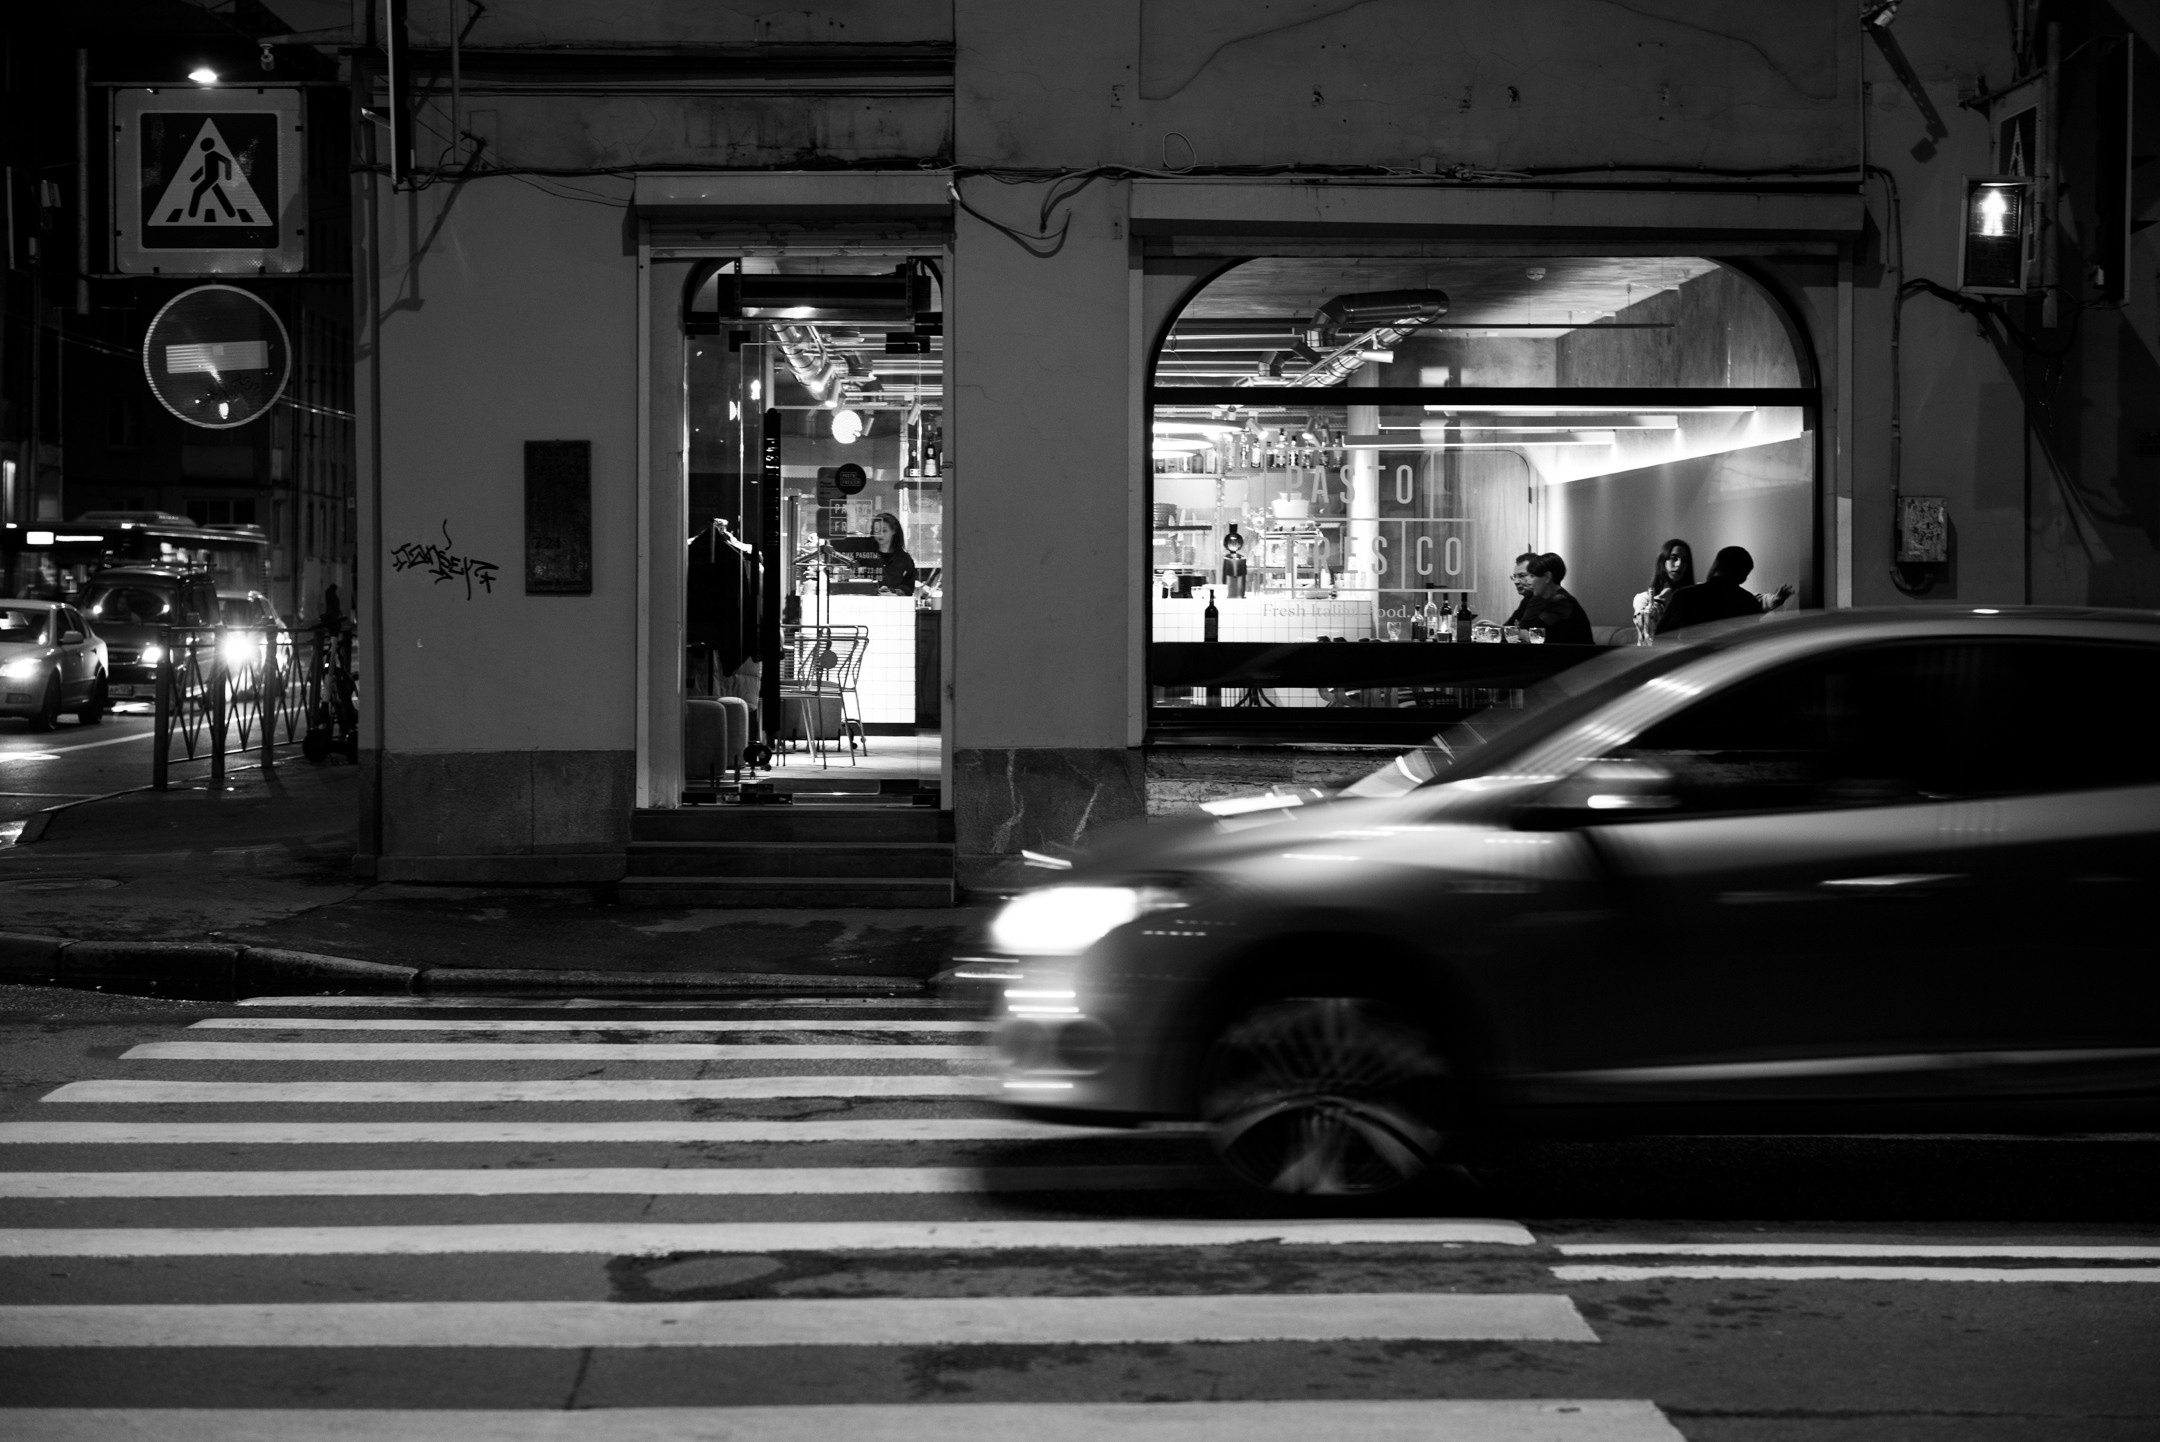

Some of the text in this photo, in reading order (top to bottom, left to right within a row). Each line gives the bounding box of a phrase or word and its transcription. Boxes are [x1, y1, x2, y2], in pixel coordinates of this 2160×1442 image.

[1286, 464, 1413, 505] PASTO
[834, 503, 868, 515] PATO
[1263, 603, 1306, 617] Fresh
